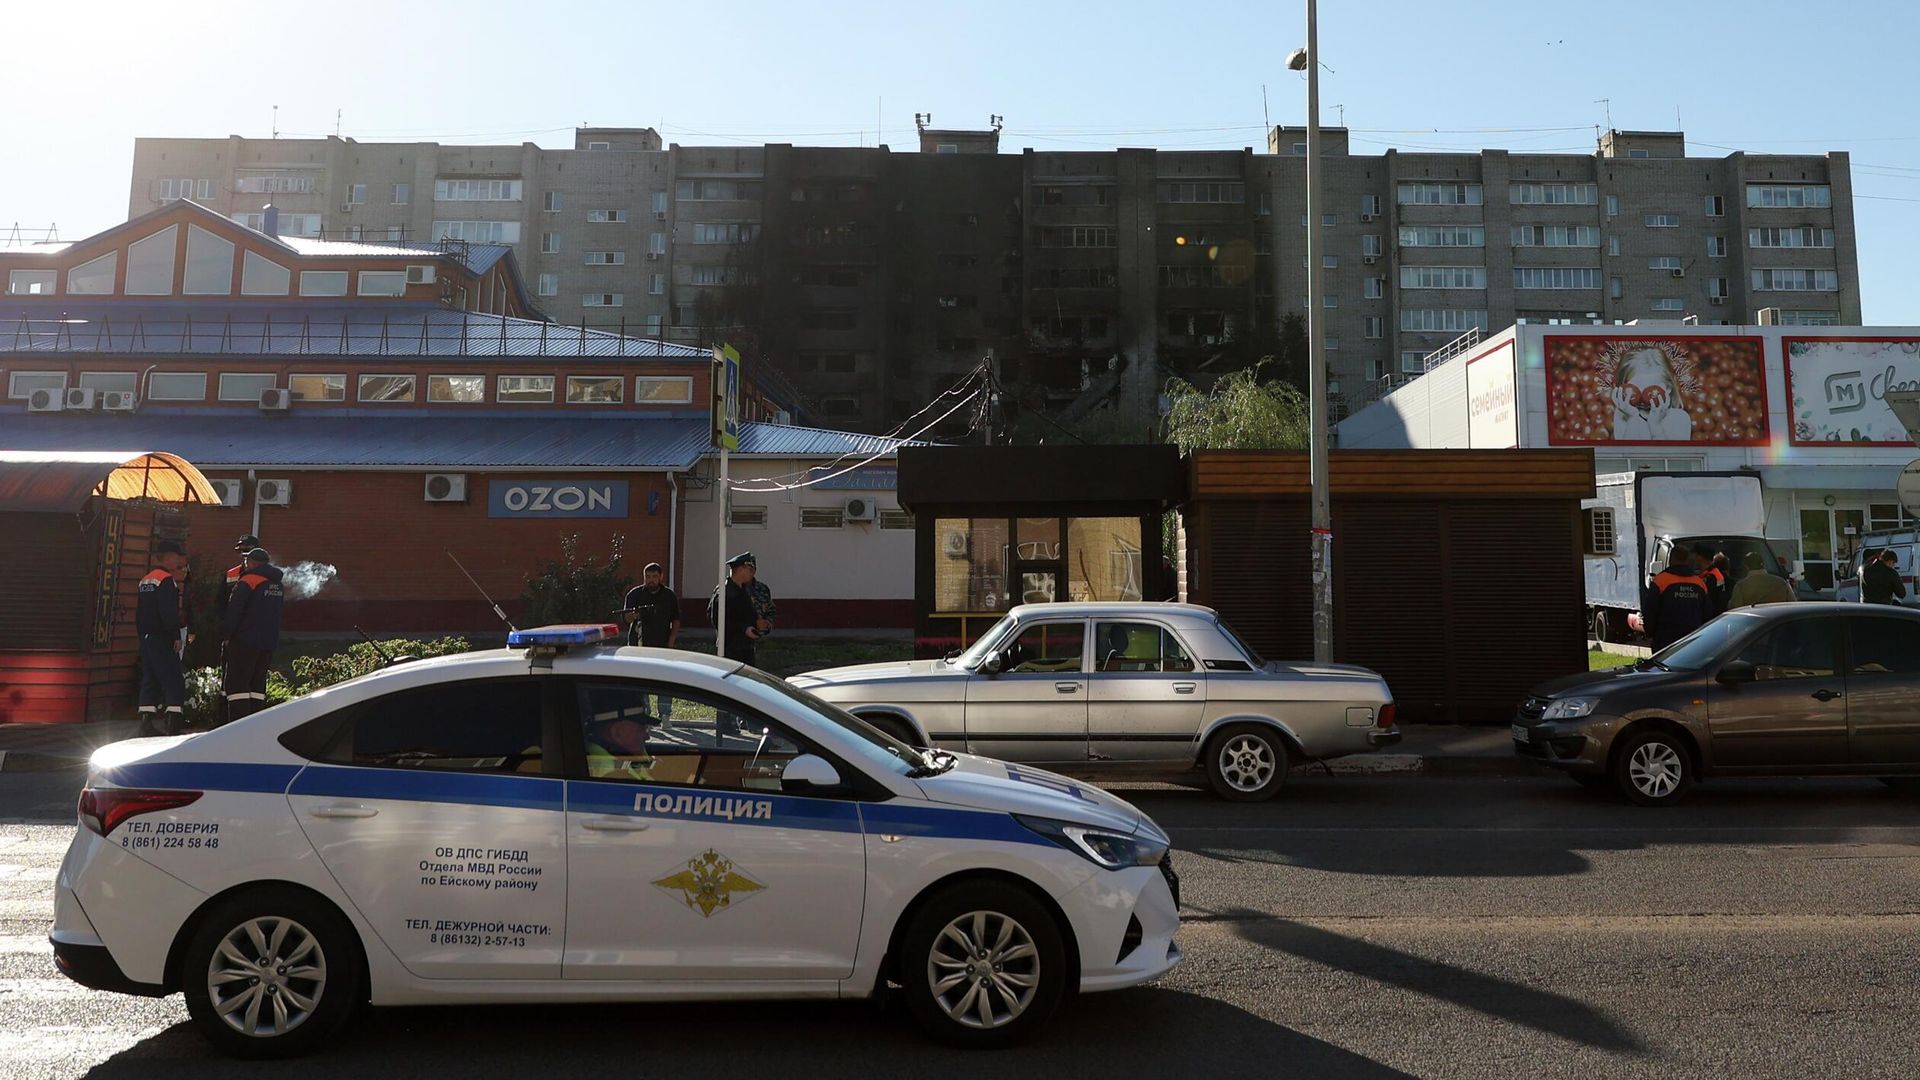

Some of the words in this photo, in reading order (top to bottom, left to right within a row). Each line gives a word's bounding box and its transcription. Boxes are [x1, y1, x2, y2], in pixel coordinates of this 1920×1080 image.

[504, 486, 611, 511] OZON
[97, 515, 118, 643] ЦВЕТЫ
[633, 792, 773, 821] ПОЛИЦИЯ
[127, 822, 153, 833] ТЕЛ.
[156, 822, 219, 835] ДОВЕРИЯ
[122, 836, 129, 848] 8
[132, 836, 161, 851] (861)
[163, 837, 184, 848] 224
[187, 837, 201, 849] 58
[204, 838, 219, 849] 48
[435, 847, 453, 858] ОВ
[456, 848, 483, 860] ДПС
[487, 849, 529, 862] ГИБДД
[420, 861, 463, 872] Отдела
[467, 863, 495, 875] МВД
[498, 863, 542, 876] России
[421, 875, 436, 886] по
[440, 875, 491, 889] Ейскому
[494, 878, 538, 891] району
[405, 919, 432, 930] ТЕЛ.
[435, 920, 504, 933] ДЕЖУРНОЙ
[508, 923, 551, 936] ЧАСТИ:
[430, 933, 437, 944] 8
[440, 934, 481, 947] (86132)
[485, 935, 525, 947] 2-57-13
